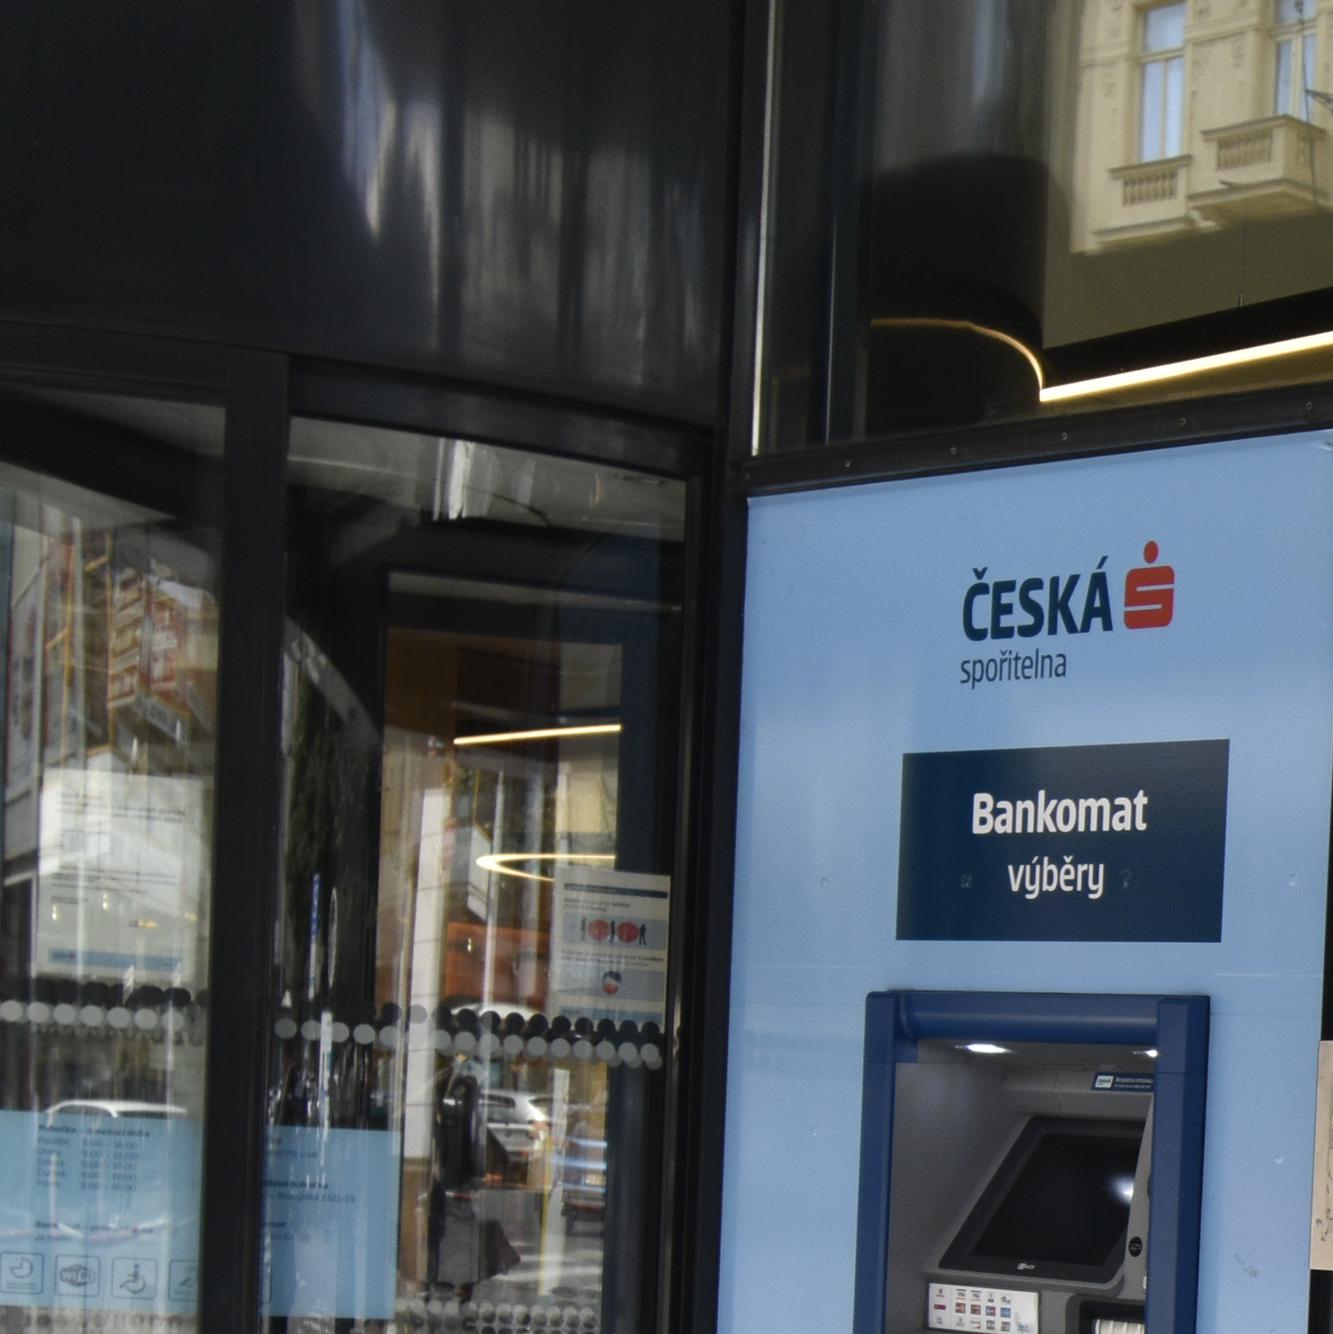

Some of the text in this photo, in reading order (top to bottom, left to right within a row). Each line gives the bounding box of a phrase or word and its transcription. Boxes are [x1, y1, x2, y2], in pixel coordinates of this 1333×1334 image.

[962, 555, 1113, 641] ČESKÁ
[960, 648, 1067, 689] spořitelna
[971, 789, 1149, 835] Bankomat
[1007, 855, 1105, 899] výběry
